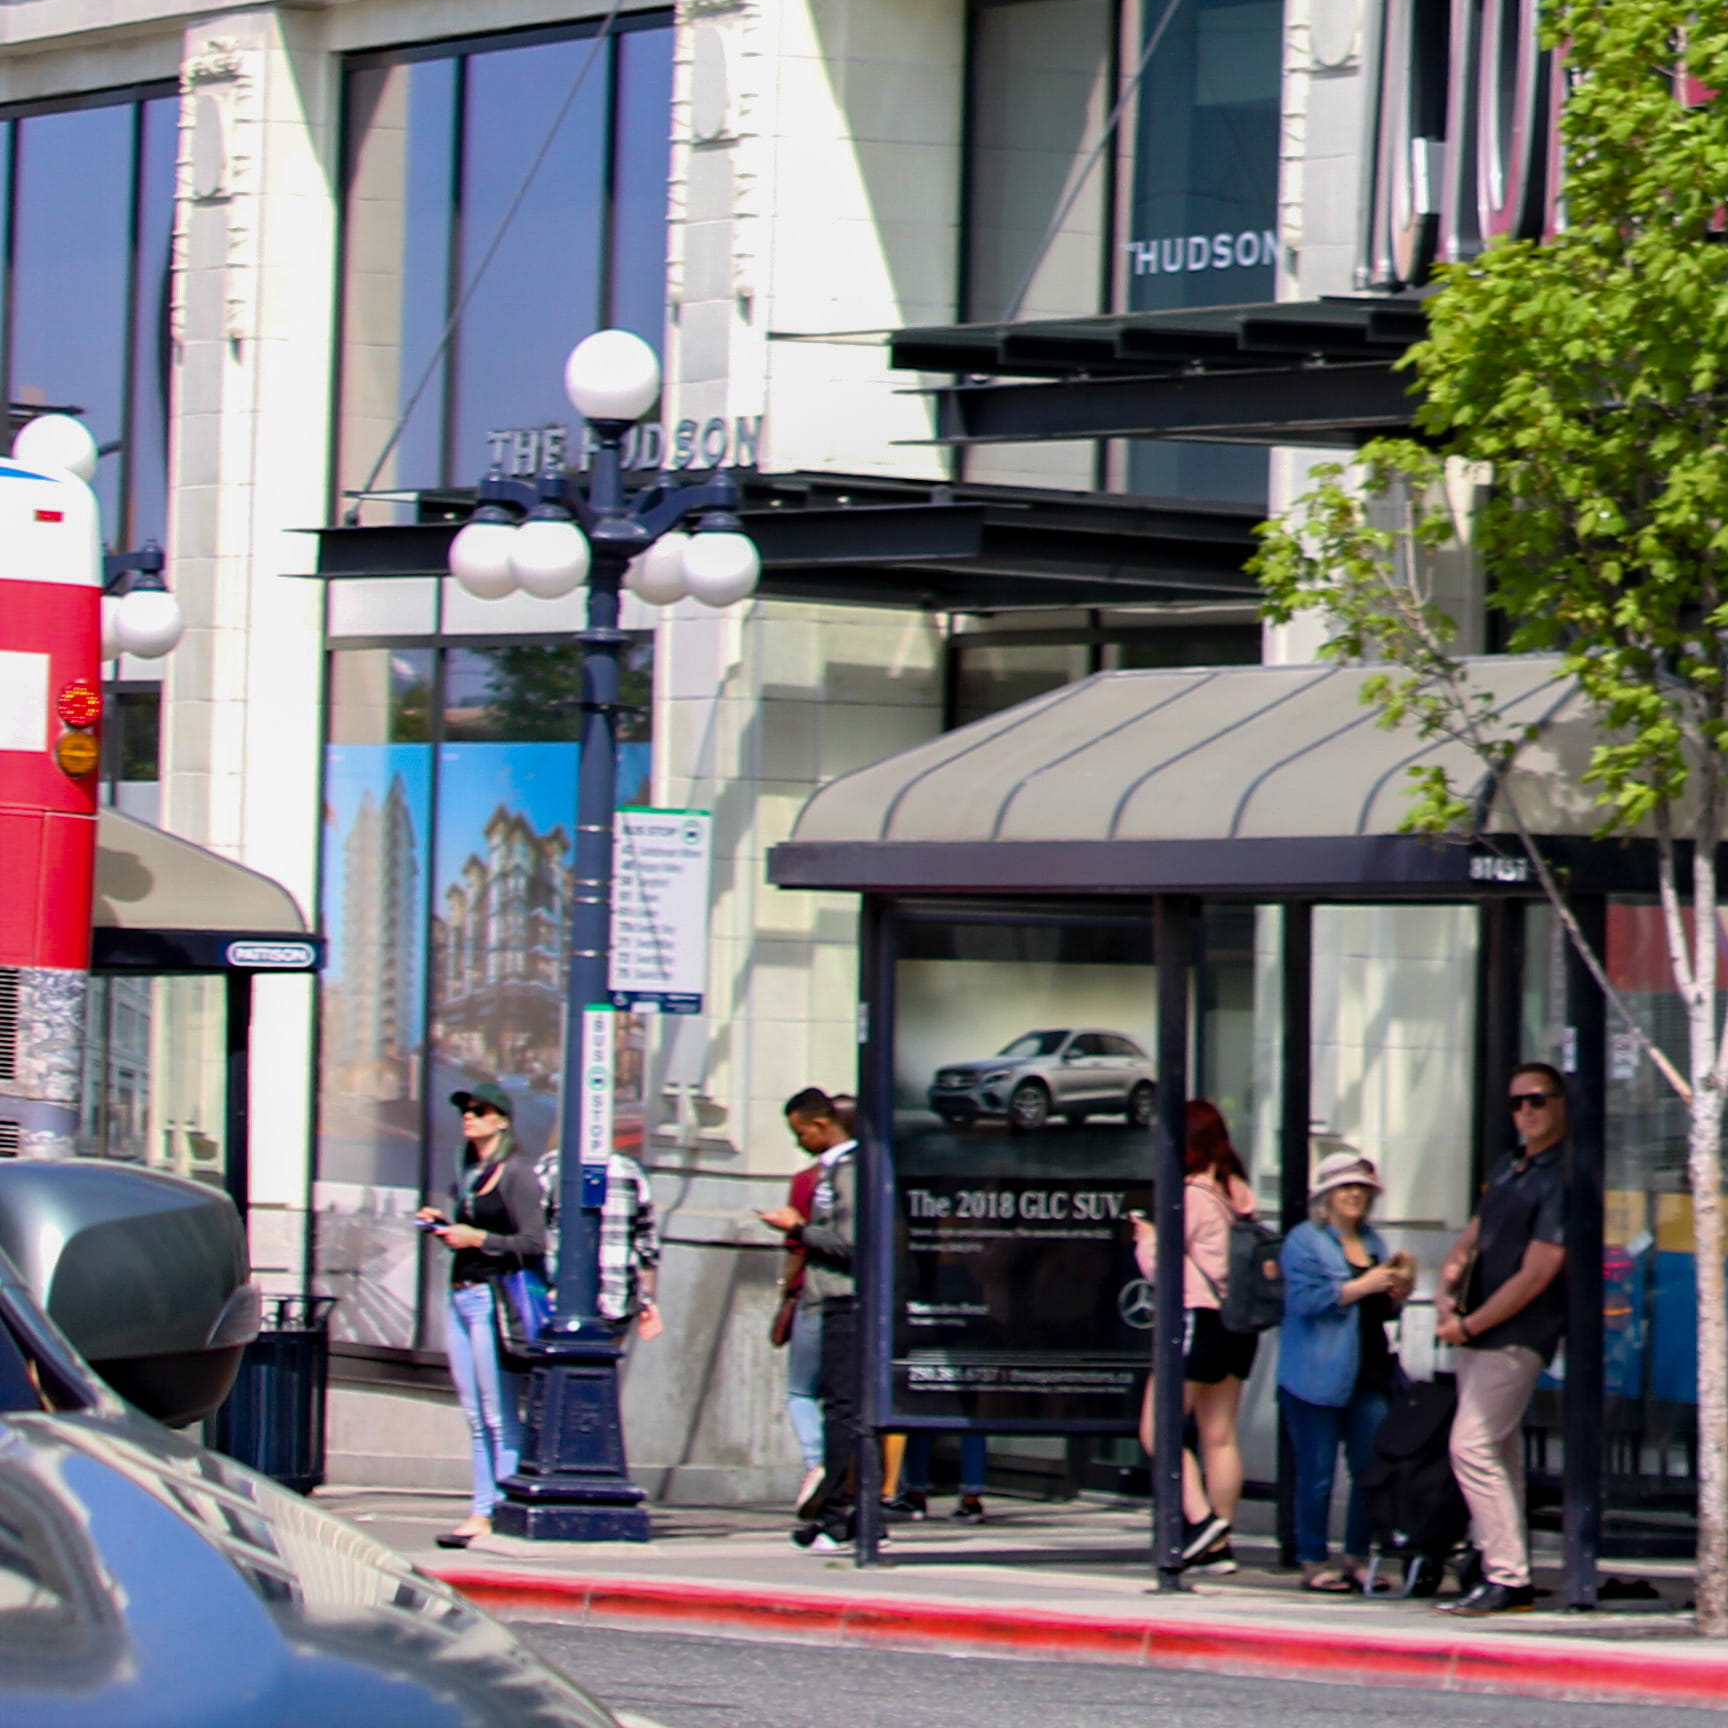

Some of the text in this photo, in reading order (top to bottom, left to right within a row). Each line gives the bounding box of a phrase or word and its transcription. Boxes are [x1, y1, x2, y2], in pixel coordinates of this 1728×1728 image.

[488, 425, 567, 475] THE
[589, 1094, 605, 1153] STOP
[907, 1189, 951, 1218] The
[955, 1190, 1016, 1219] 2018
[1018, 1190, 1069, 1221] GLC
